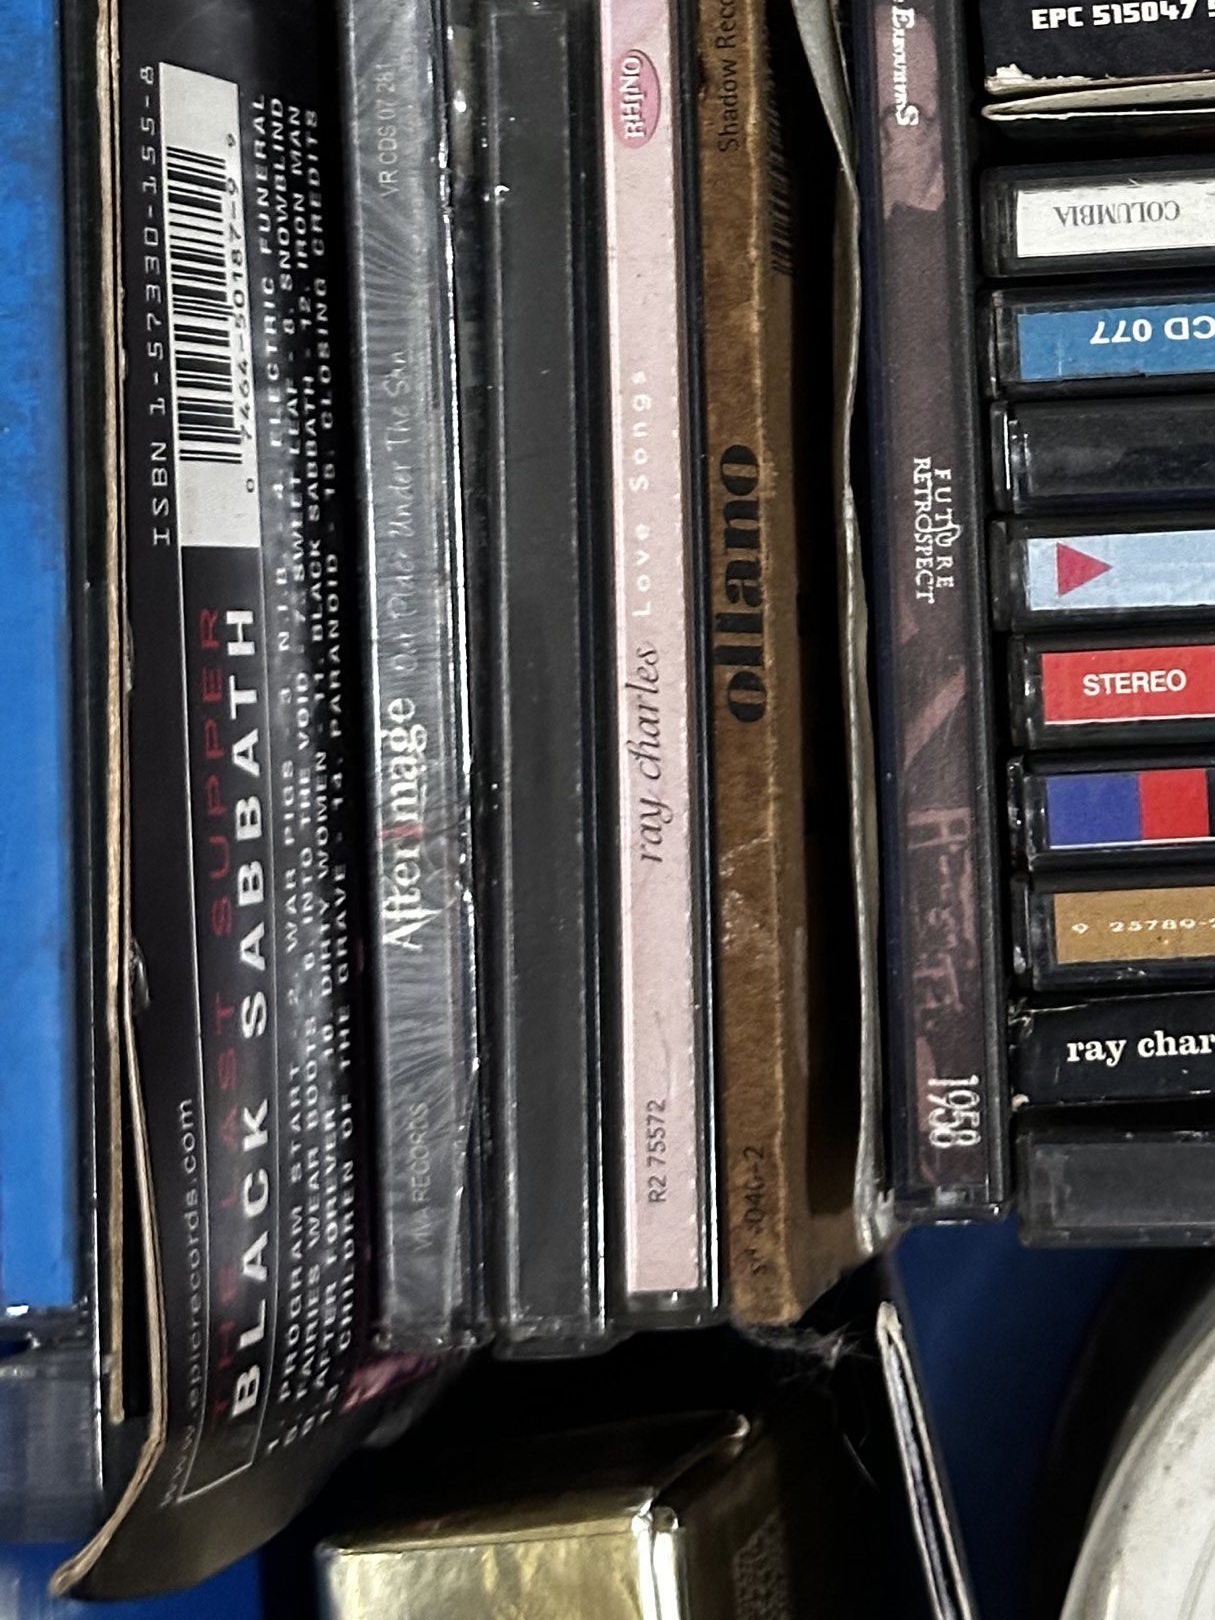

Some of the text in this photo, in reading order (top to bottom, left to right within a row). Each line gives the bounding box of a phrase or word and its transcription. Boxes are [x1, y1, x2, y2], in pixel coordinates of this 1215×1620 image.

[1031, 6, 1084, 30] EPC
[624, 54, 649, 141] RHINO
[714, 59, 743, 153] Shadow
[1052, 200, 1181, 227] COLUMBIA
[1089, 318, 1153, 345] 077
[152, 440, 171, 547] ISBN
[913, 457, 935, 605] RETROSPECT
[934, 468, 960, 589] FUTURE
[715, 443, 768, 725] ollano
[1082, 669, 1187, 696] STEREO
[624, 647, 674, 863] ray charles
[224, 609, 270, 1419] BLACK SABBATH
[1066, 1039, 1127, 1068] ray
[645, 1099, 667, 1205] R2 75572
[927, 1074, 981, 1149] 1958
